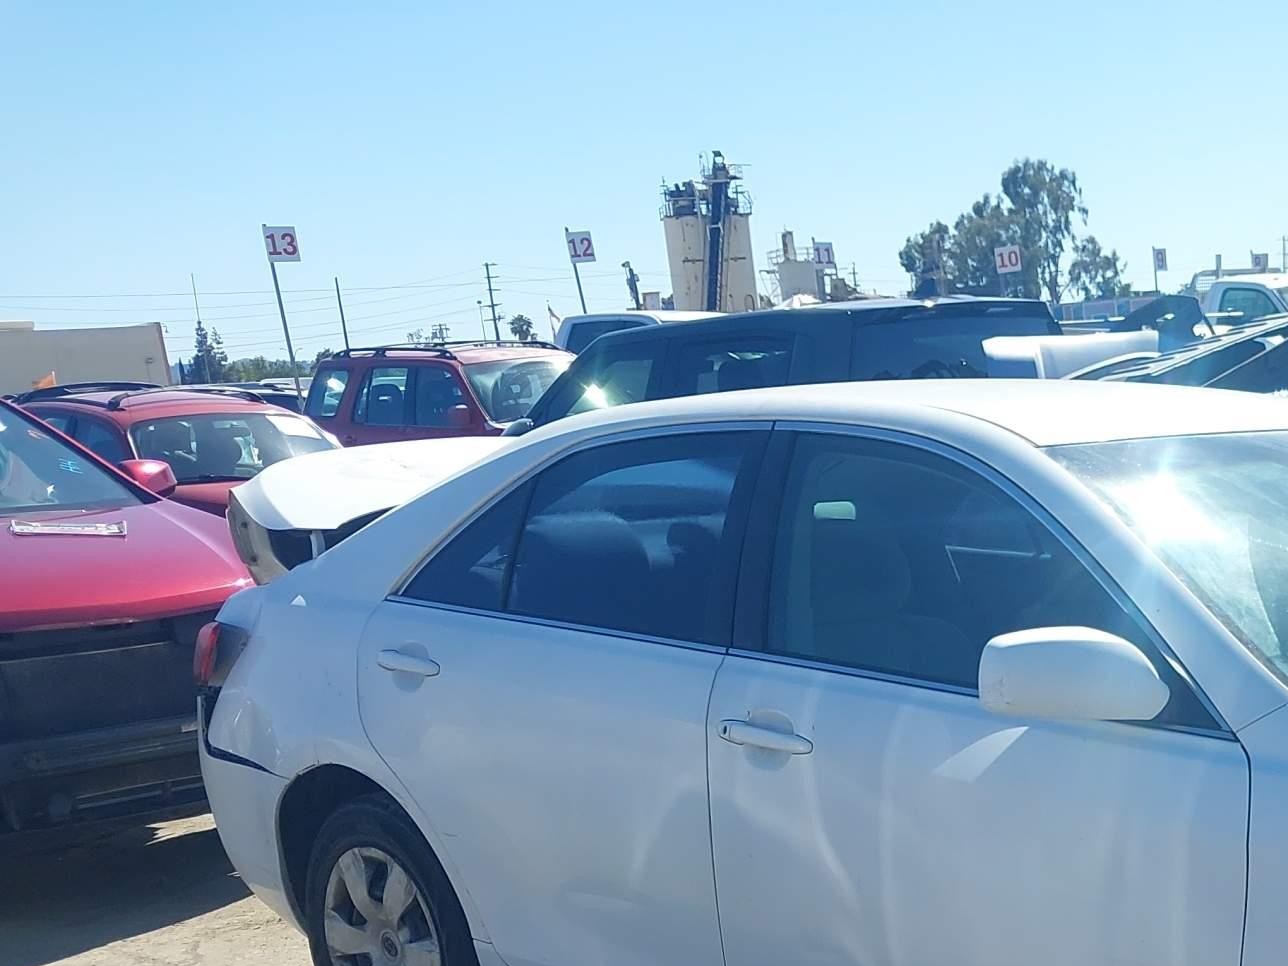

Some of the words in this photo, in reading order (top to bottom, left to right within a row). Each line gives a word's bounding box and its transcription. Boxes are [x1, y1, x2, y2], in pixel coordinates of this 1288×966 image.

[265, 232, 298, 256] 13
[567, 237, 594, 258] 12
[813, 247, 833, 264] 11
[997, 250, 1019, 268] 10
